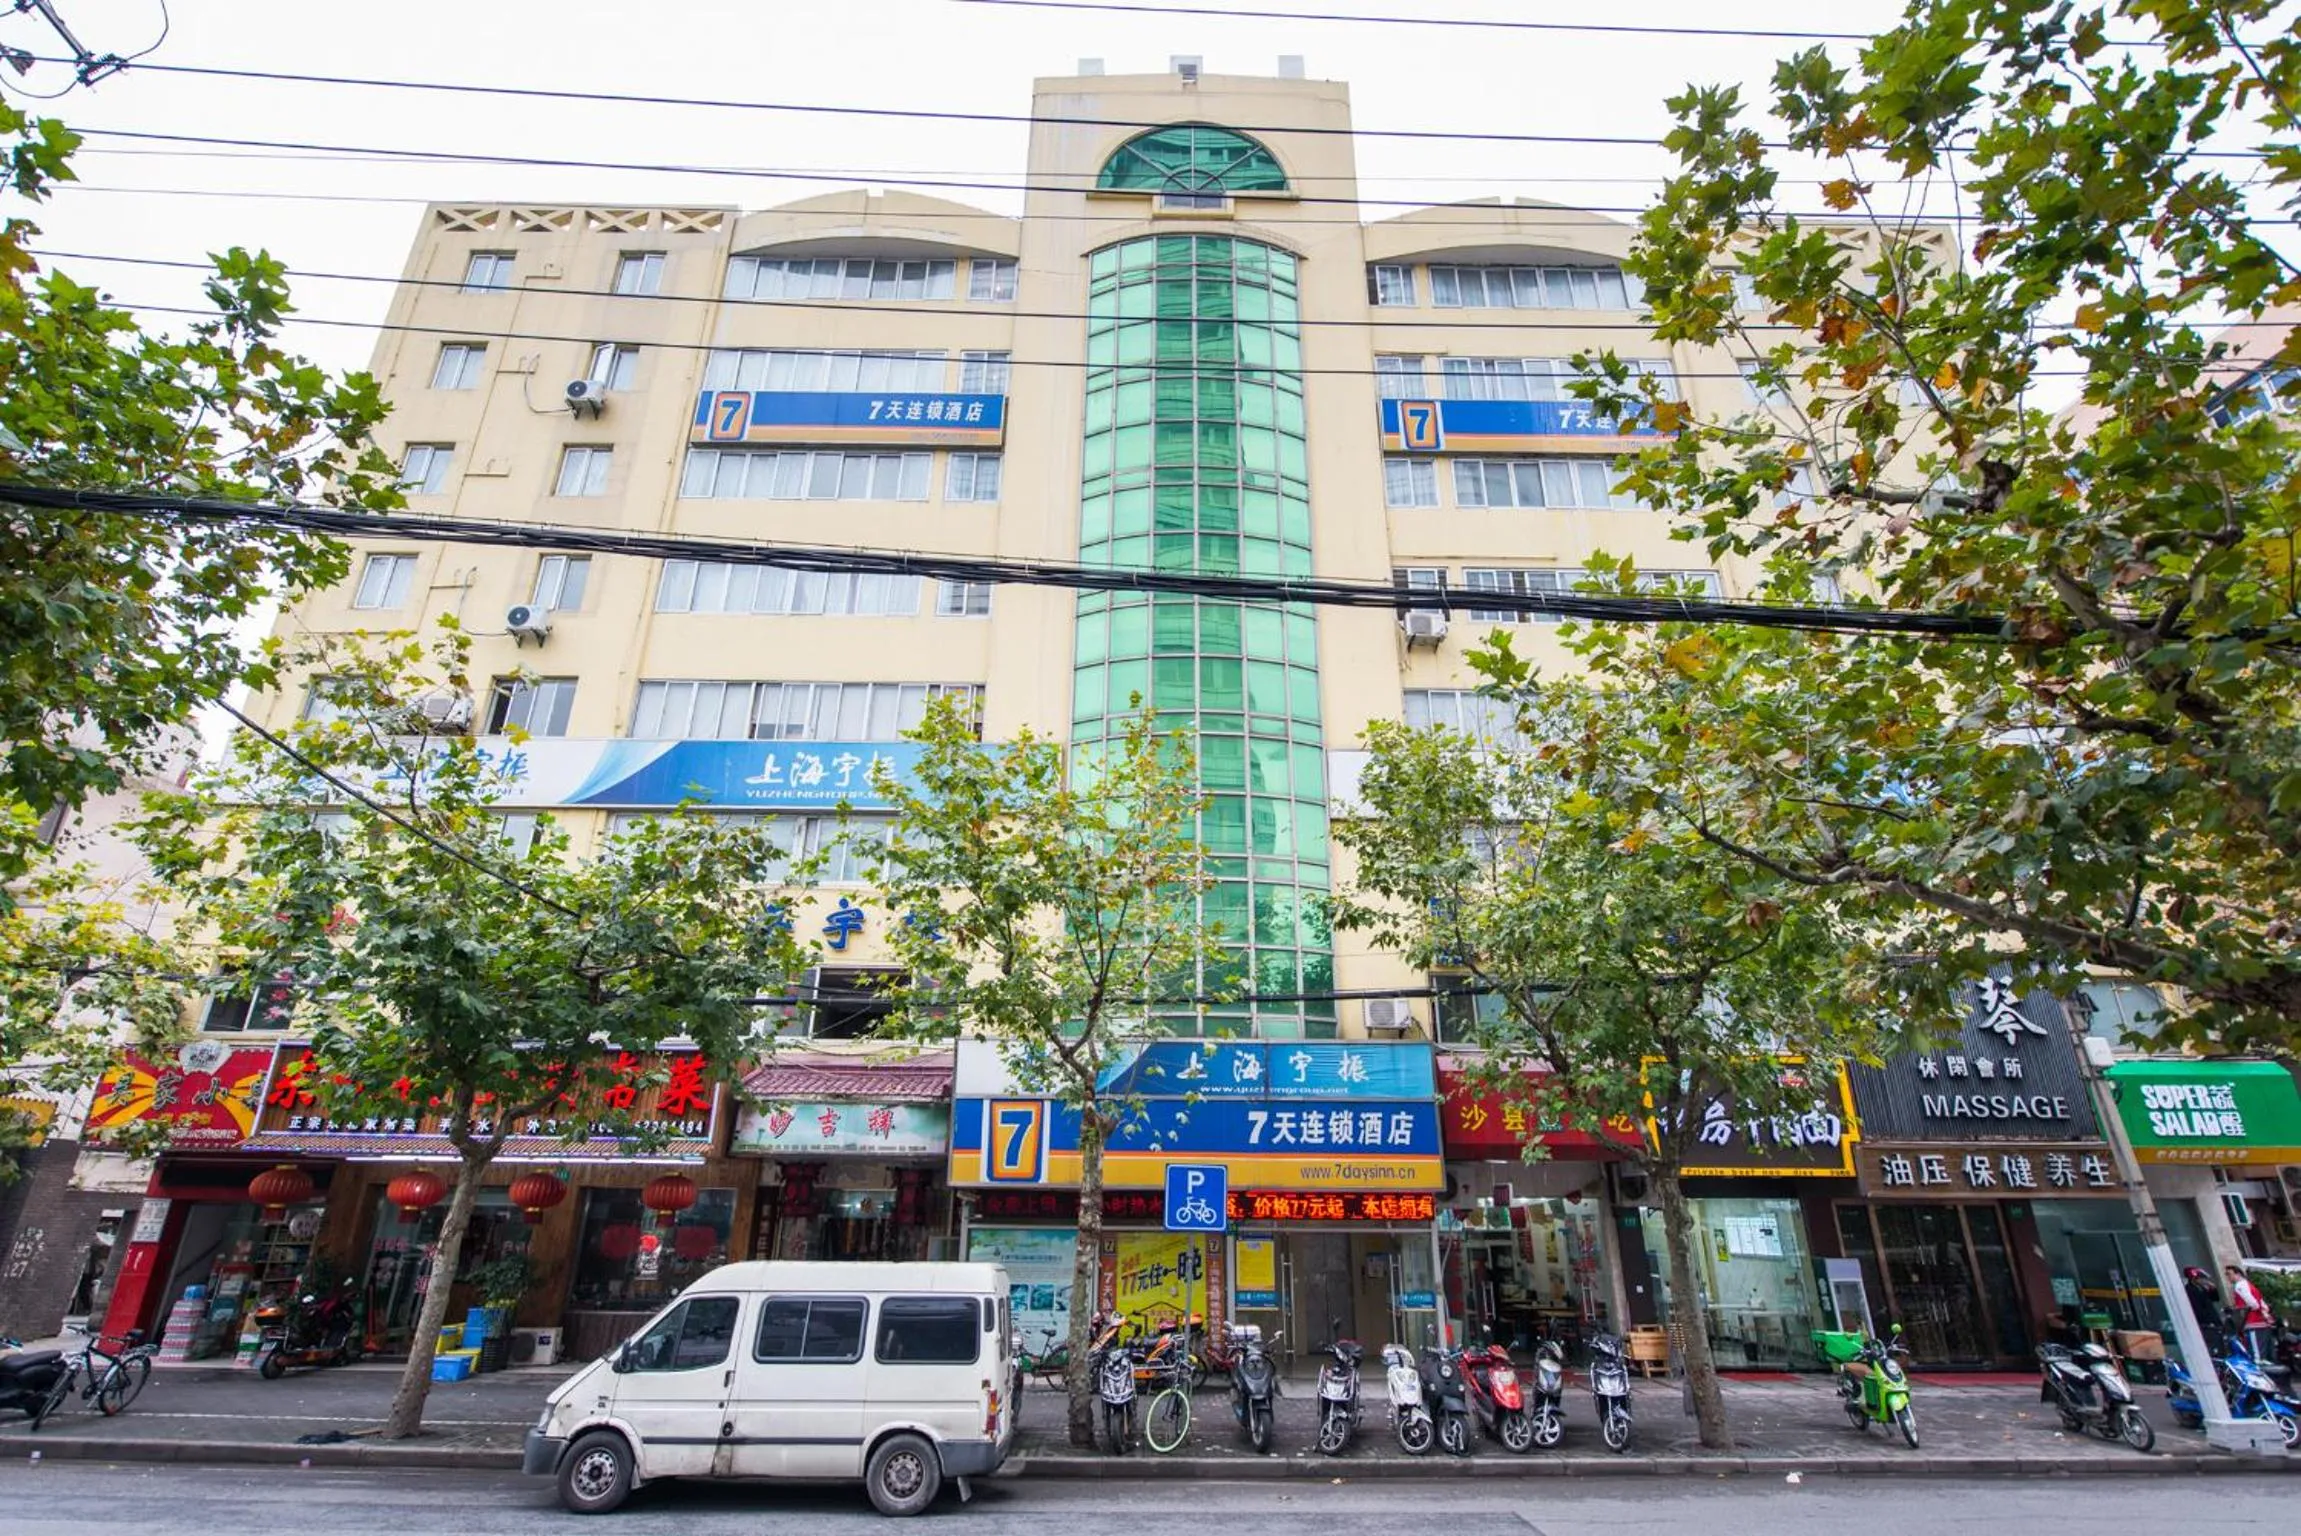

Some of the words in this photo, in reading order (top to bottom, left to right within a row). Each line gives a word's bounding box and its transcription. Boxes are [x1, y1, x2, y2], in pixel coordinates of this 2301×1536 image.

[718, 400, 744, 433] 7
[868, 400, 984, 422] 7天连锁酒店
[1408, 408, 1432, 441] 7
[1923, 1094, 2071, 1119] MASSAGE
[2140, 1084, 2213, 1110] SUPER
[1248, 1110, 1415, 1147] 7天连锁酒店
[2149, 1111, 2223, 1137] SALAD
[999, 1108, 1034, 1168] 7
[1188, 1172, 1205, 1193] P
[1300, 1163, 1416, 1181] www.7daysinn.cn
[1881, 1153, 2116, 1188] 油压保健养生
